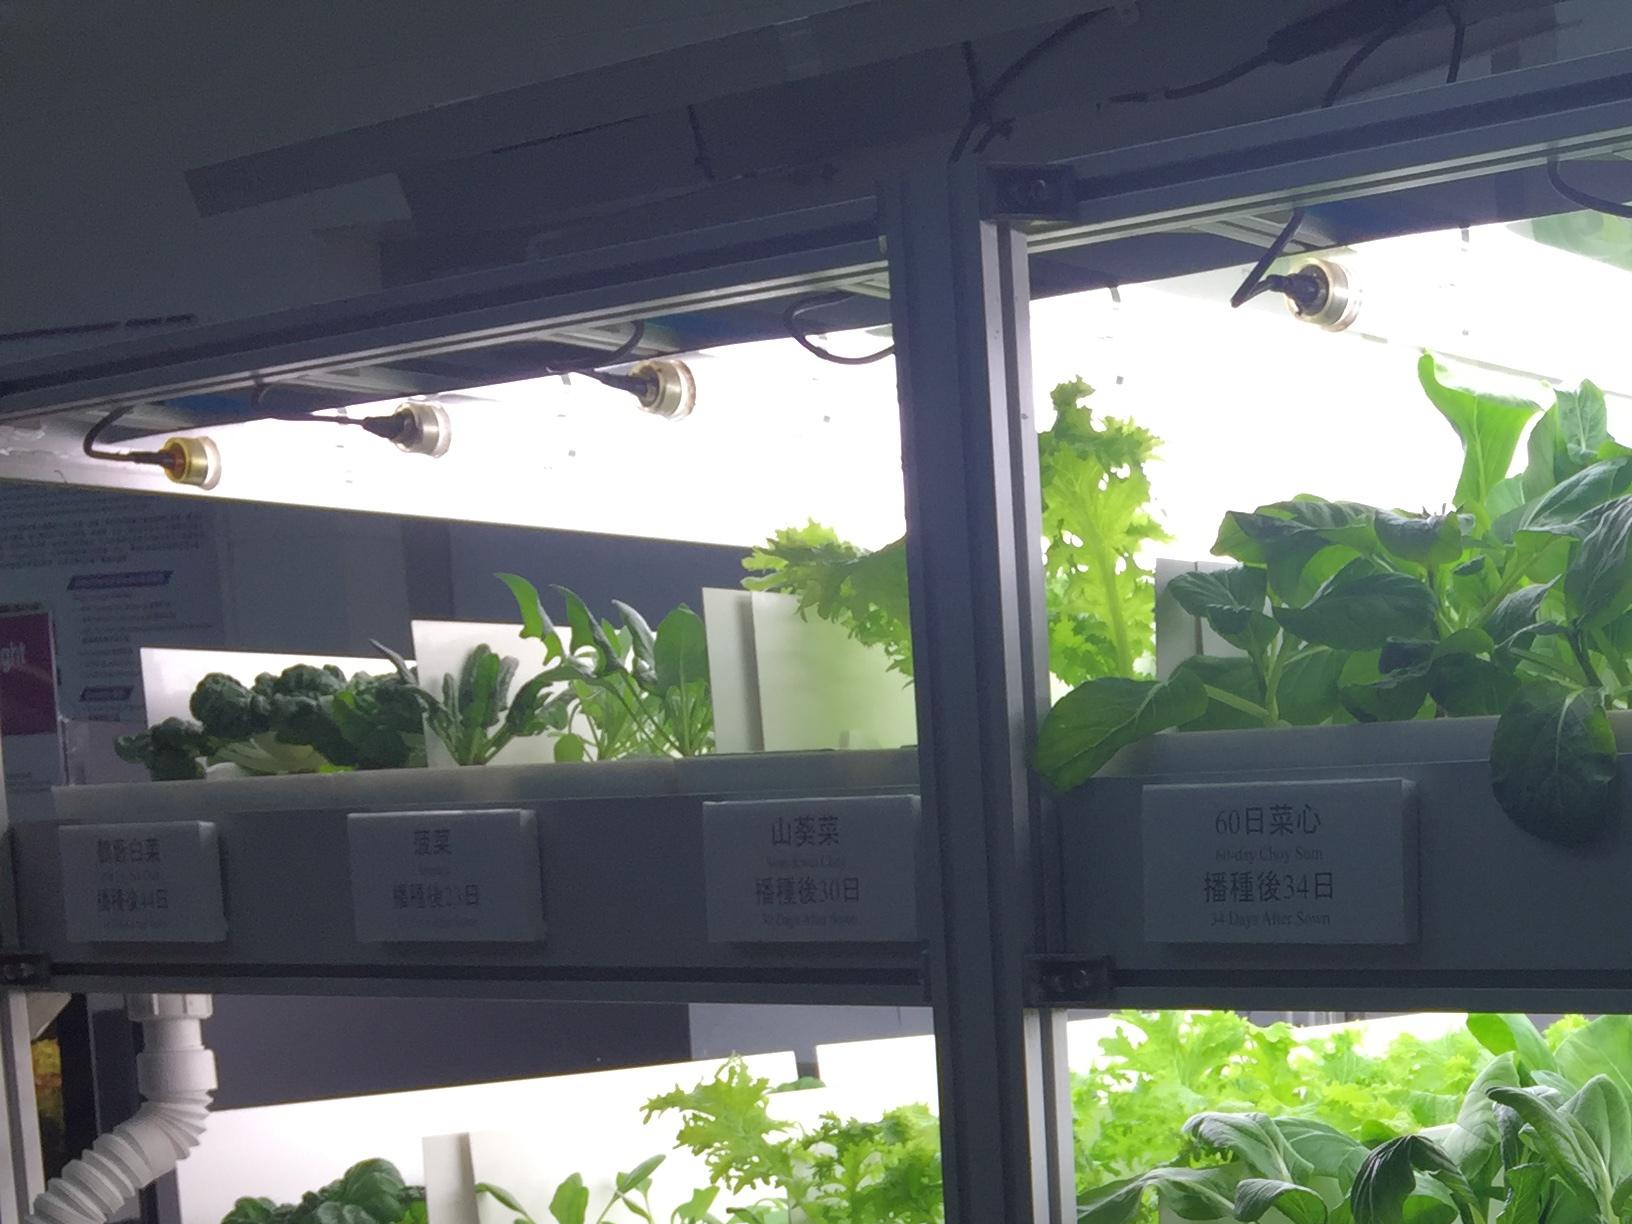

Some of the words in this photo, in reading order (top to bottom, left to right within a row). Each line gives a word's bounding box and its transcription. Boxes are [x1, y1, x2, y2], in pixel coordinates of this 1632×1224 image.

[771, 815, 841, 848] 山葵菜
[1214, 803, 1323, 837] 60日菜心
[1202, 869, 1335, 904] 播種後34日
